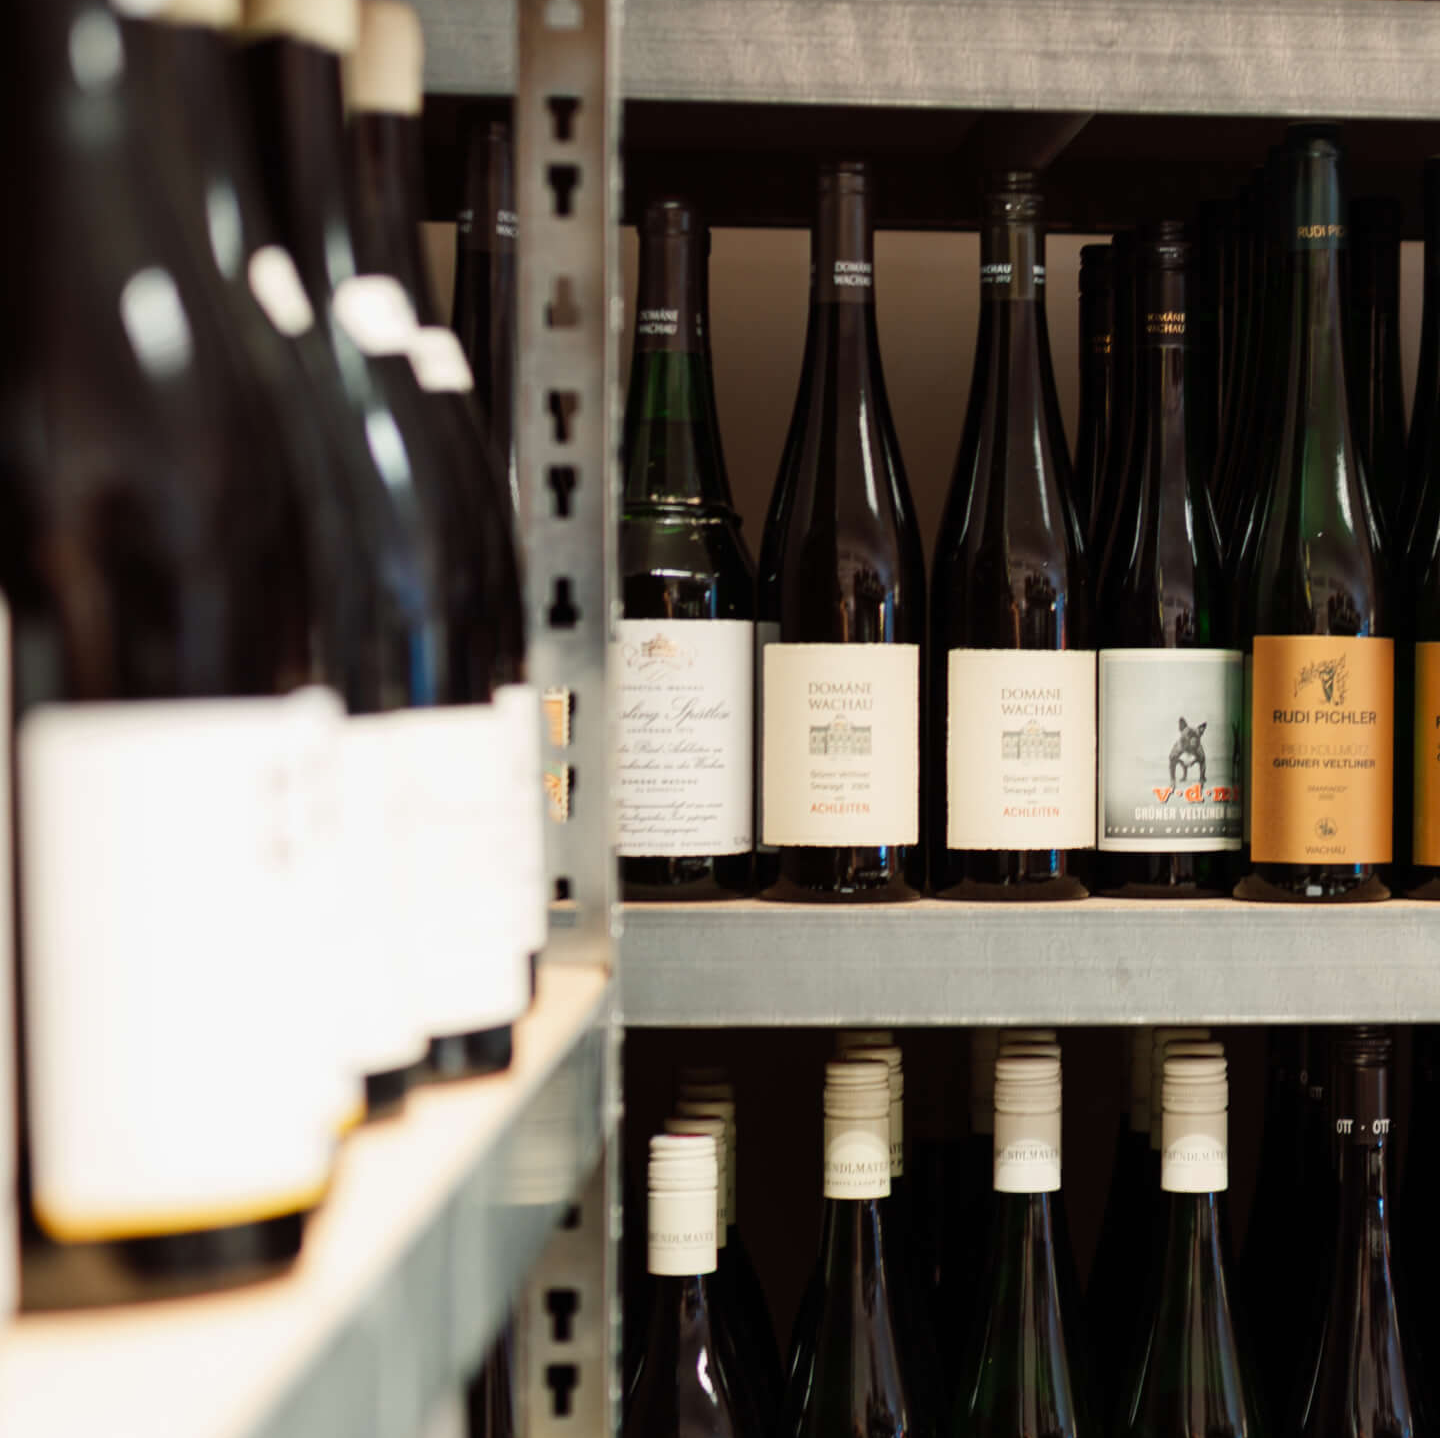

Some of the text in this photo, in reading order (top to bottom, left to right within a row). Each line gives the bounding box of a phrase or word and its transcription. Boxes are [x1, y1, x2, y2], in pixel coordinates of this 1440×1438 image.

[808, 680, 872, 694] DOMÄNE
[1000, 687, 1062, 701] DOMÄNE
[808, 698, 873, 711] WACHAU
[1000, 703, 1063, 716] WACHAU
[1273, 709, 1377, 726] RUDI PICHLER
[1272, 757, 1376, 770] GRÜNER VELTLINER
[810, 802, 870, 815] ACHLEITEN
[1003, 807, 1060, 818] ACHLEITEN
[1134, 806, 1176, 821] GRÜNER
